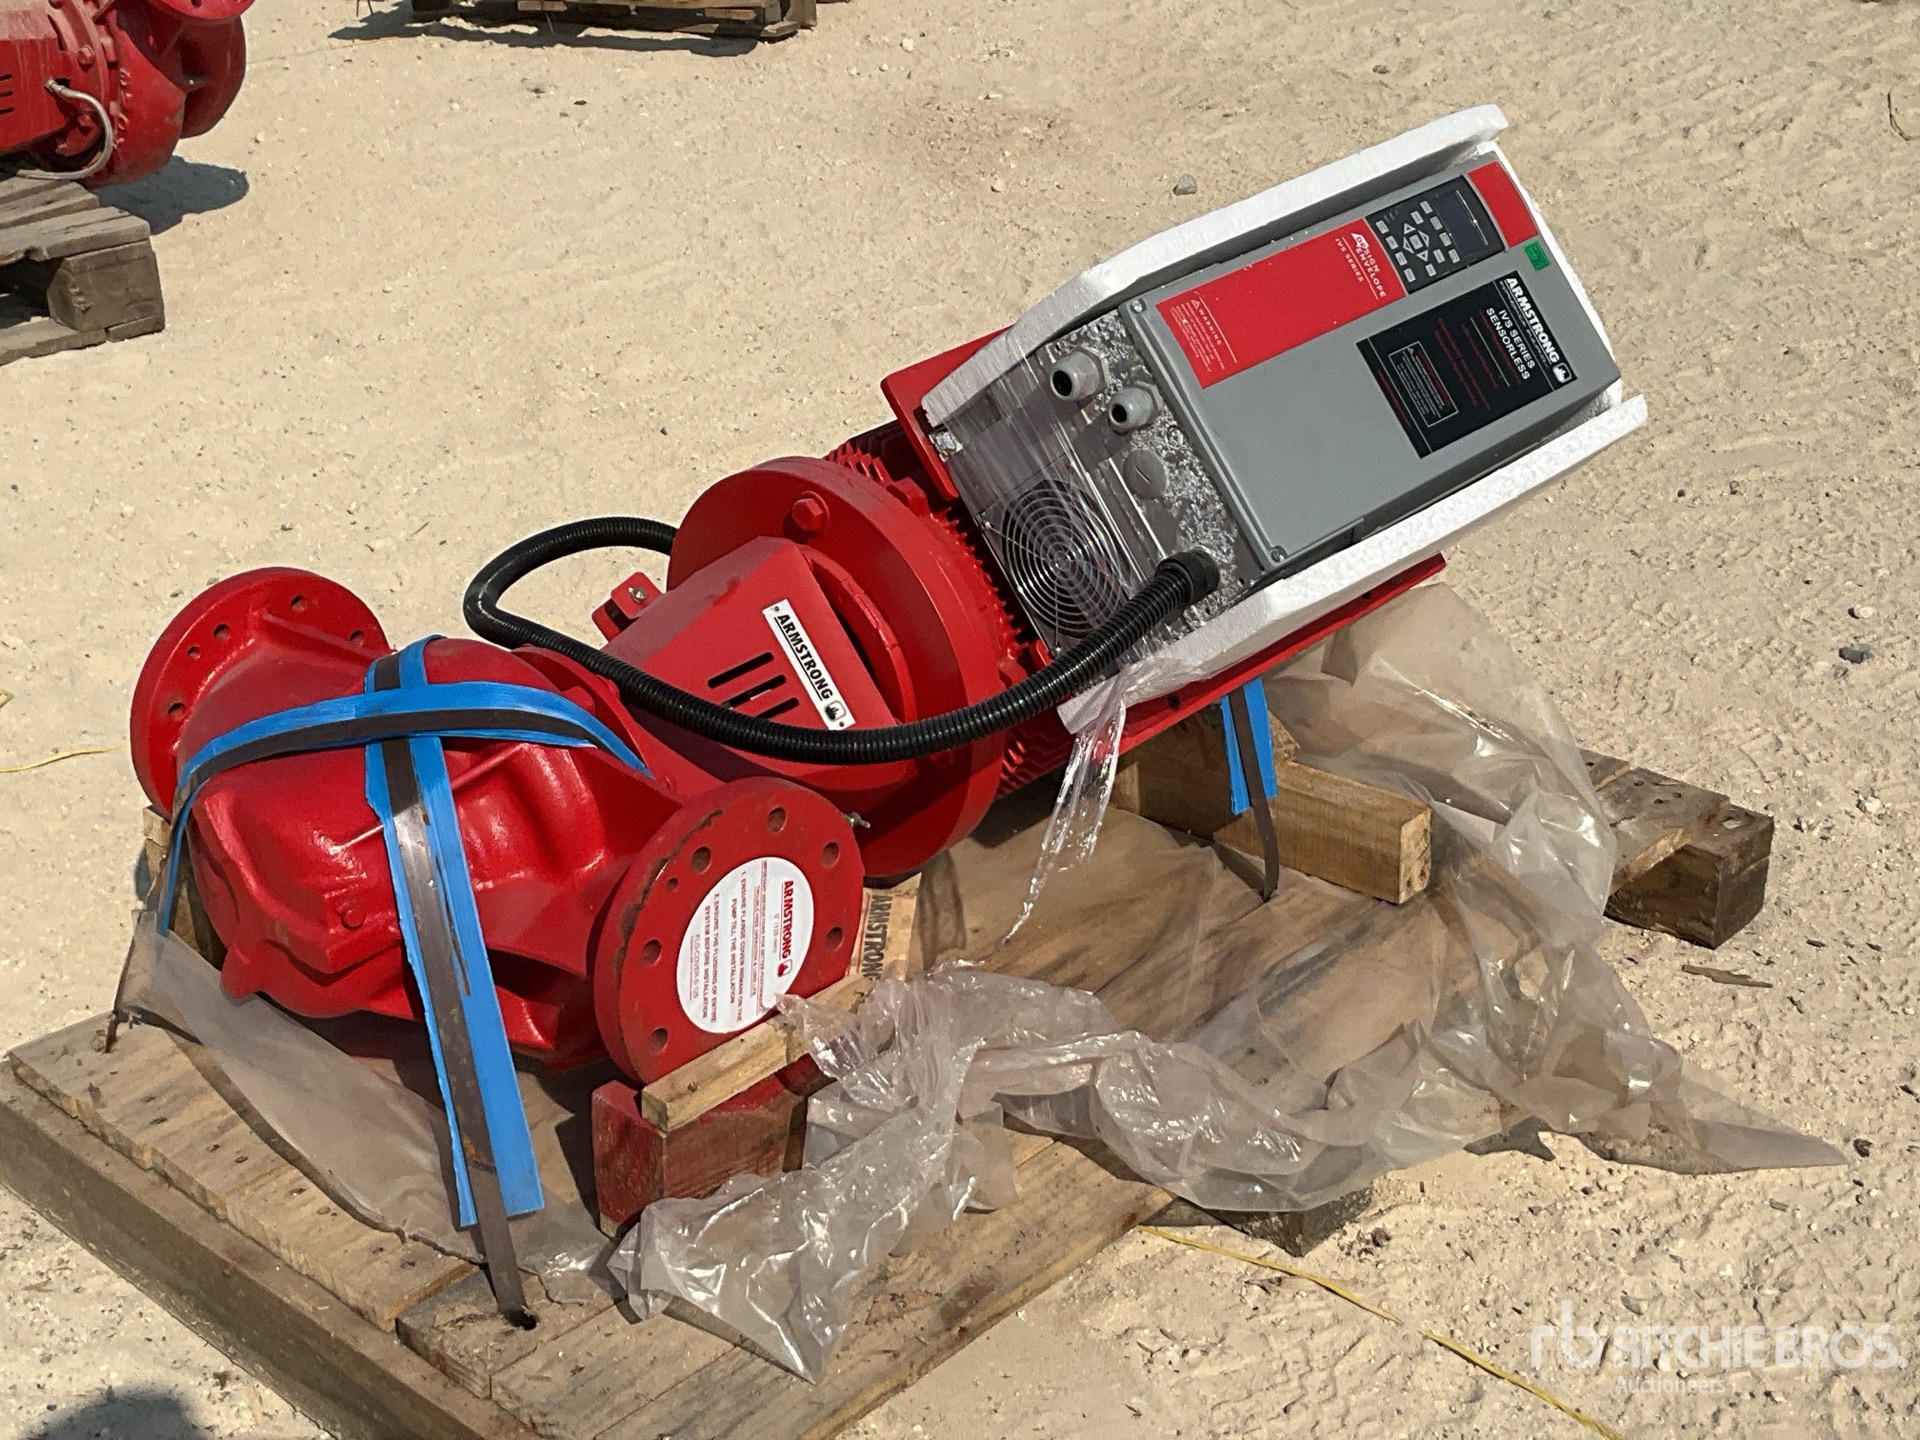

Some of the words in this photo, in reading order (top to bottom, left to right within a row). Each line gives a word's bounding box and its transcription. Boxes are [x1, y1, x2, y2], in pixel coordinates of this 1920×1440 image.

[1345, 254, 1364, 282] SERIES
[1355, 247, 1387, 297] ENVELOPE
[1486, 307, 1530, 379] SENSORLESS
[1498, 309, 1513, 328] IVS
[1509, 329, 1535, 369] SERIES
[1505, 278, 1560, 363] ARMSTRONG
[777, 614, 834, 700] ARMSTRONG
[782, 880, 793, 959] ARMSTRONG
[701, 967, 709, 1018] INSTALLATION
[711, 985, 717, 996] OF
[737, 996, 742, 1007] ON
